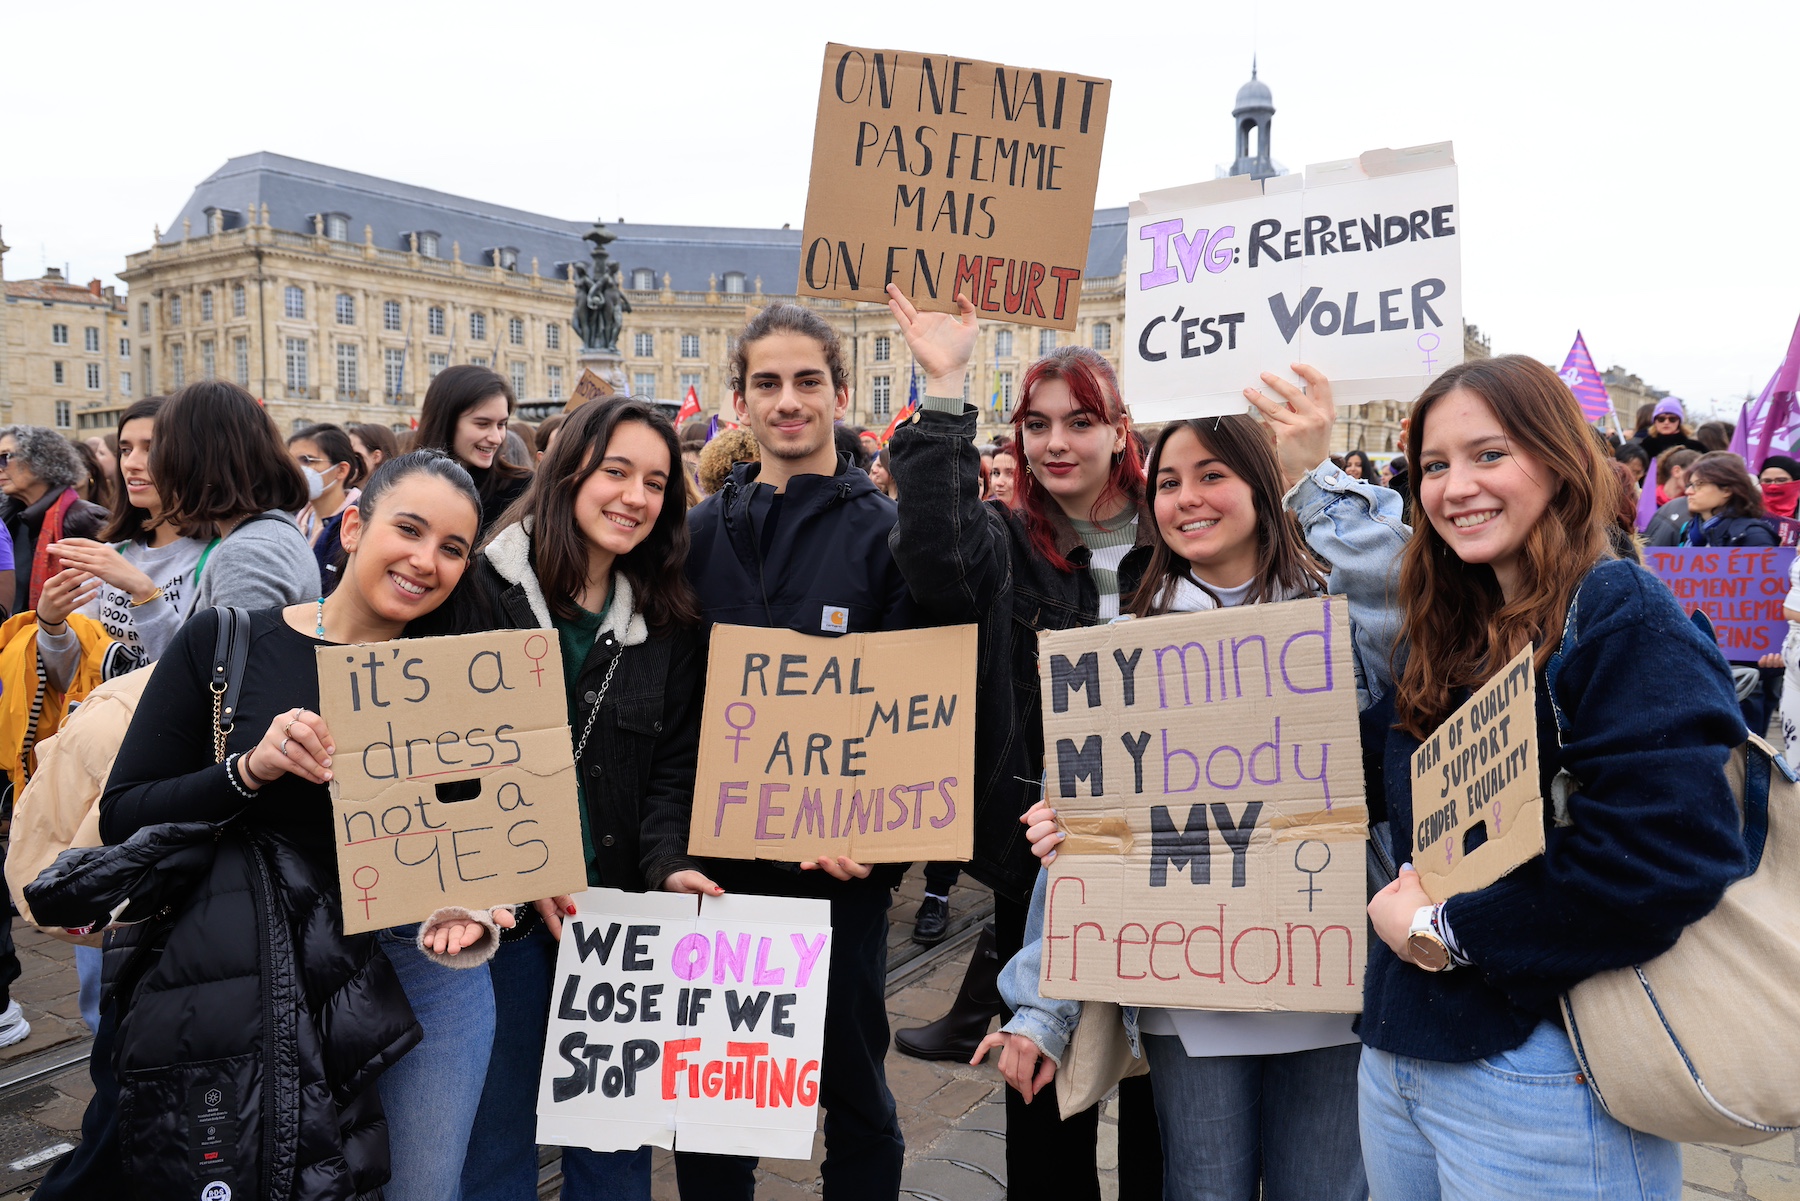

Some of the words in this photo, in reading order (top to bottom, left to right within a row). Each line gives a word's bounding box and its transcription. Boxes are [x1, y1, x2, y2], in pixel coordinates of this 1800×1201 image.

[835, 50, 898, 109] ON
[918, 57, 973, 115] NE
[991, 66, 1104, 134] NAIT
[855, 121, 938, 177] PAS
[946, 131, 1066, 190] FEMME
[893, 184, 997, 239] MAIS
[1139, 217, 1240, 291] IVG:
[1248, 204, 1456, 268] REPRENDRE
[805, 237, 865, 291] ON
[884, 246, 945, 299] EN
[952, 253, 1081, 320] MEURT
[1137, 305, 1246, 362] C'EST
[1267, 278, 1446, 345] VOLER
[1652, 552, 1685, 573] TU
[1690, 553, 1720, 574] AS
[1728, 548, 1778, 574] ÉTÉ
[346, 648, 430, 711] it's
[468, 650, 515, 694] a
[740, 652, 875, 697] REAL
[1049, 646, 1143, 714] MY
[1153, 598, 1334, 709] mind
[362, 721, 521, 780] dress
[865, 694, 957, 738] MEN
[1417, 734, 1441, 778] MEN
[1448, 716, 1464, 751] OF
[1470, 656, 1530, 734] QUALITY
[764, 731, 867, 777] ARE
[1056, 730, 1152, 798] MY
[1160, 716, 1331, 815] body
[1440, 714, 1511, 798] SUPPORT
[343, 796, 447, 843] not
[497, 782, 534, 812] a
[713, 776, 958, 840] FEMINISTS
[1417, 799, 1459, 853] GENDER
[1466, 739, 1529, 818] EQUALITY
[1149, 800, 1264, 888] MY
[571, 920, 661, 972] WE
[671, 929, 828, 987] ONLY
[1044, 876, 1356, 987] freedom
[557, 974, 664, 1023] LOSE
[676, 987, 712, 1026] IF
[724, 989, 797, 1038] WE
[552, 1031, 661, 1103] STOP
[661, 1036, 819, 1109] FIGHTING
